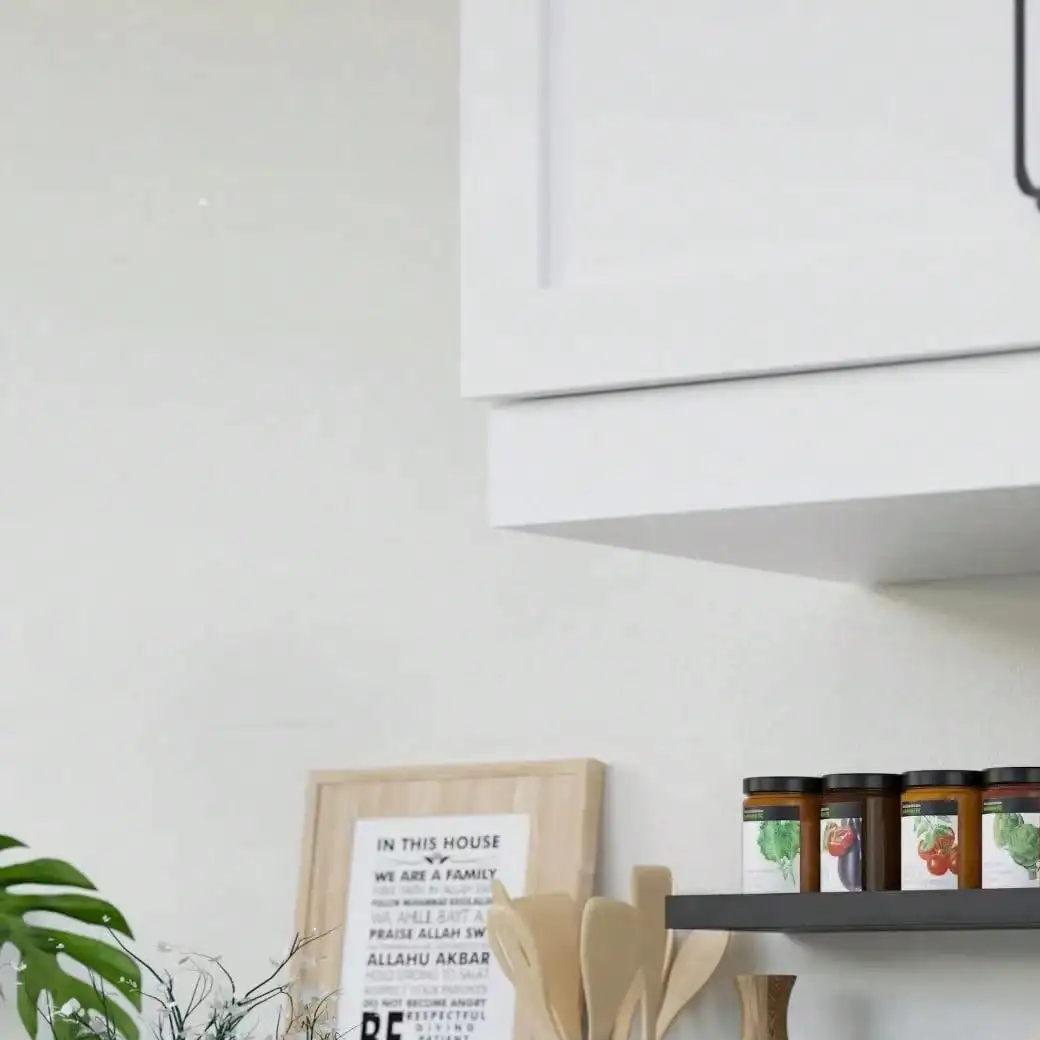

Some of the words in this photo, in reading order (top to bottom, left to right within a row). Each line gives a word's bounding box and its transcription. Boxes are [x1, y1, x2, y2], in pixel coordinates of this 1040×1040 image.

[376, 837, 395, 852] IN
[400, 836, 437, 851] THIS
[443, 834, 501, 849] HOUSE
[375, 871, 395, 883] WE
[400, 869, 426, 882] ARE
[431, 869, 441, 881] A
[446, 868, 498, 881] FAMILY
[369, 928, 412, 940] PRAISE
[418, 927, 461, 939] ALLAH
[367, 952, 430, 966] ALLAHU
[435, 951, 490, 965] AKBAR
[407, 1010, 486, 1021] RESPECTFUL
